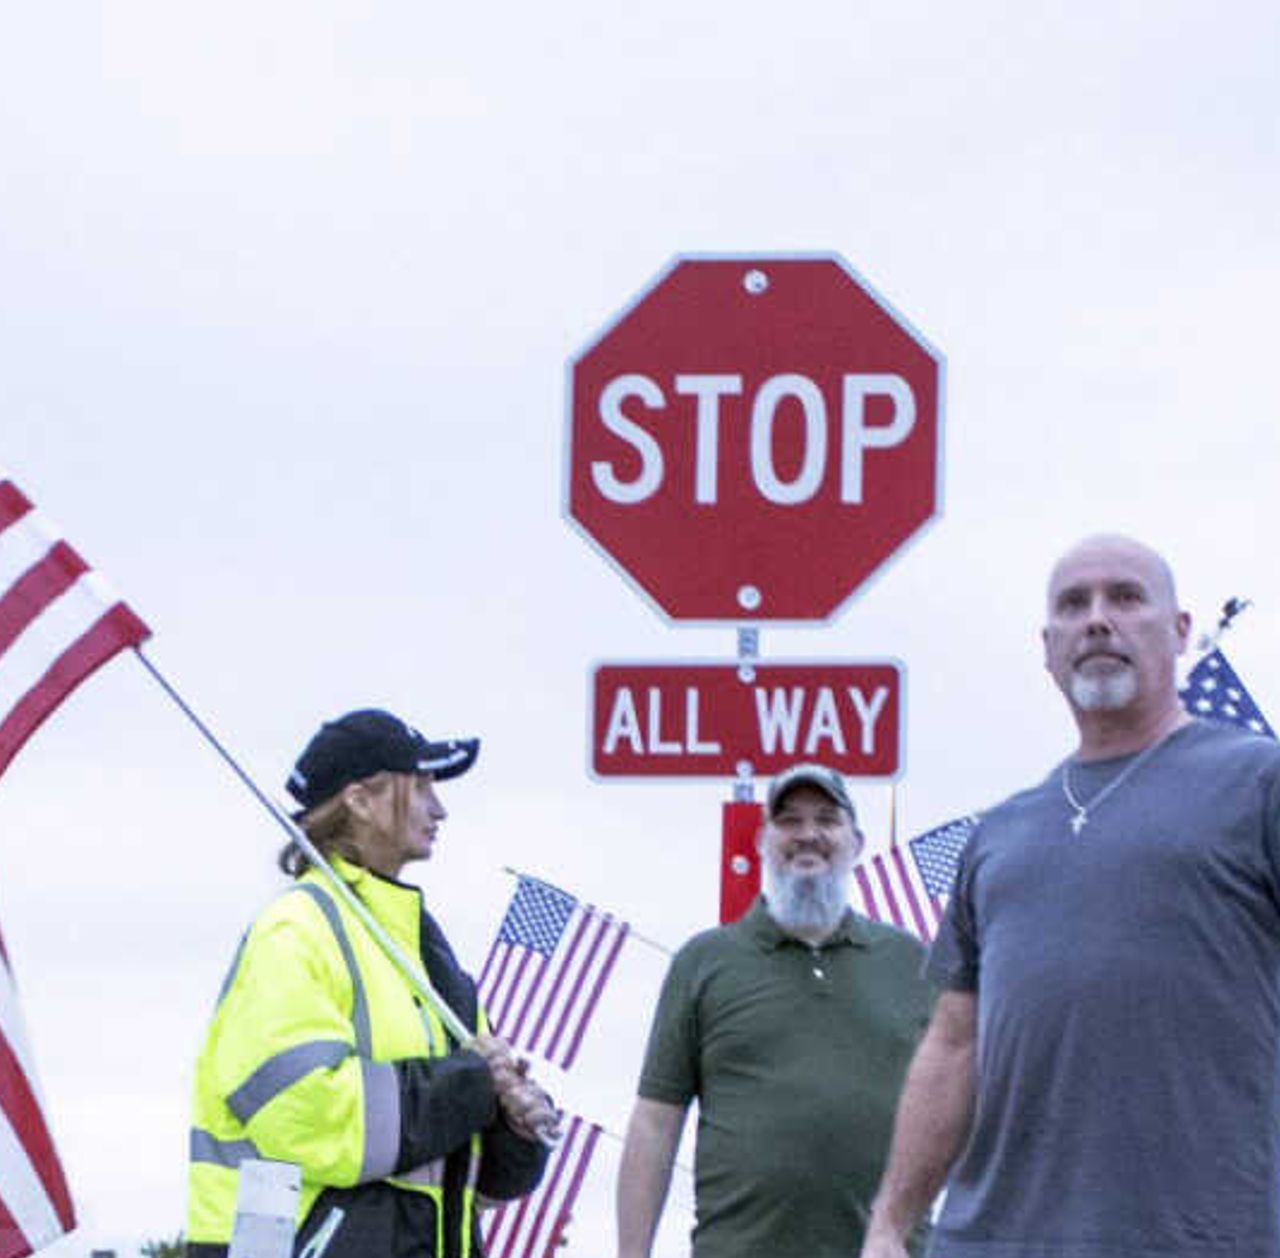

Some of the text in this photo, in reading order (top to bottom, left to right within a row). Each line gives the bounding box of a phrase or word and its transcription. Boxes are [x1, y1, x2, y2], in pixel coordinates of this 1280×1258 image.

[590, 372, 917, 506] STOP
[602, 686, 889, 756] ALL WAY
